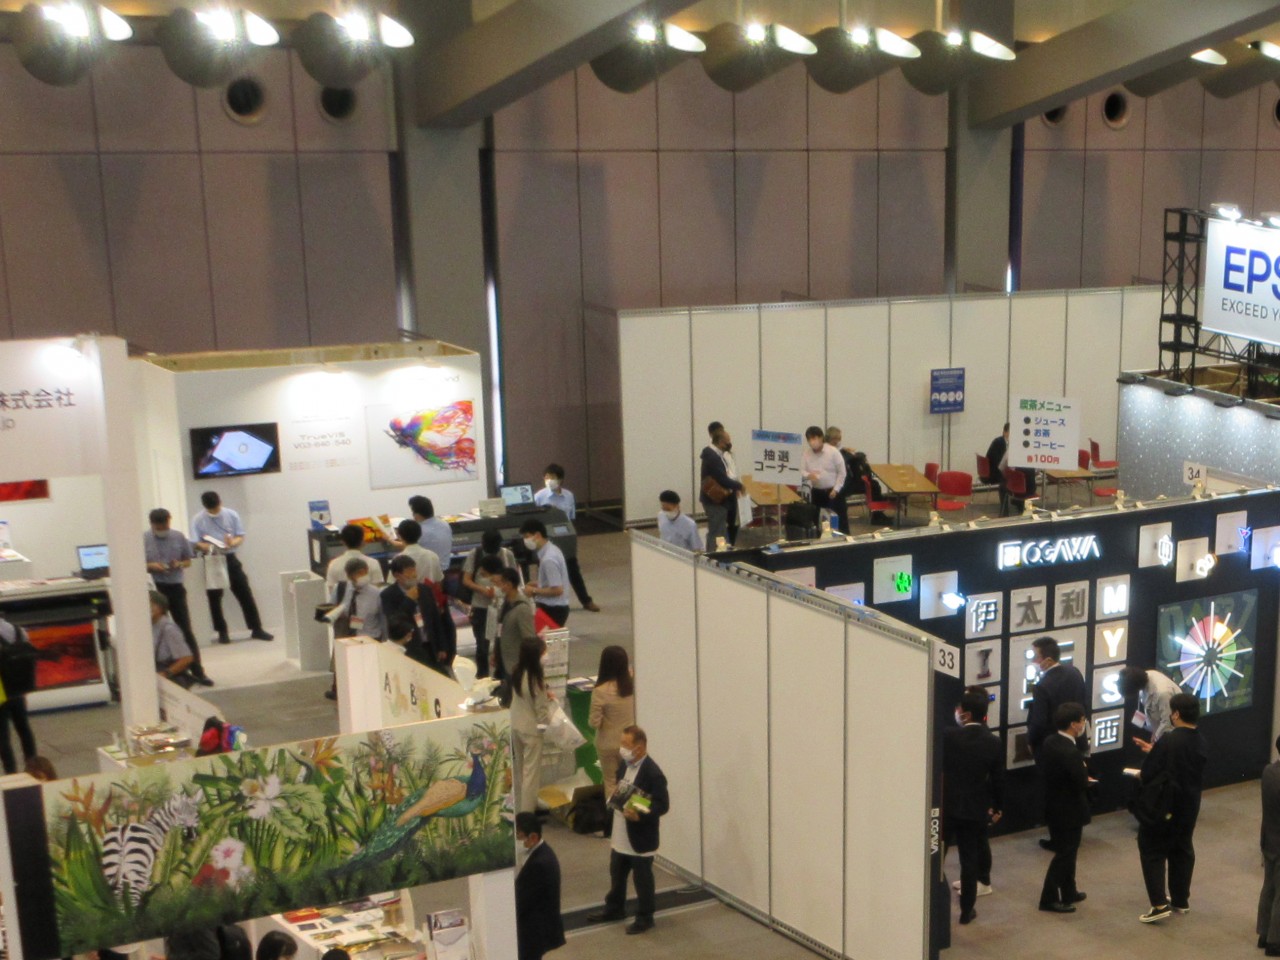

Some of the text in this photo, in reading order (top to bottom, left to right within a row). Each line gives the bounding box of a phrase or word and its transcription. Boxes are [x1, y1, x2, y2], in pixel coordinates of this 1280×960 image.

[1221, 297, 1268, 320] EXCEED
[1019, 399, 1072, 412] 喫茶メニュー
[1034, 416, 1066, 427] ジュース
[1034, 429, 1050, 438] お茶
[1033, 440, 1065, 450] コーヒー
[764, 448, 789, 463] 抽選
[754, 461, 799, 473] コーナー
[970, 584, 1127, 633] 伊 太 利 M
[1102, 628, 1125, 657] Y
[937, 647, 957, 671] 33
[384, 672, 391, 694] A
[410, 683, 417, 706] B
[434, 698, 441, 718] C
